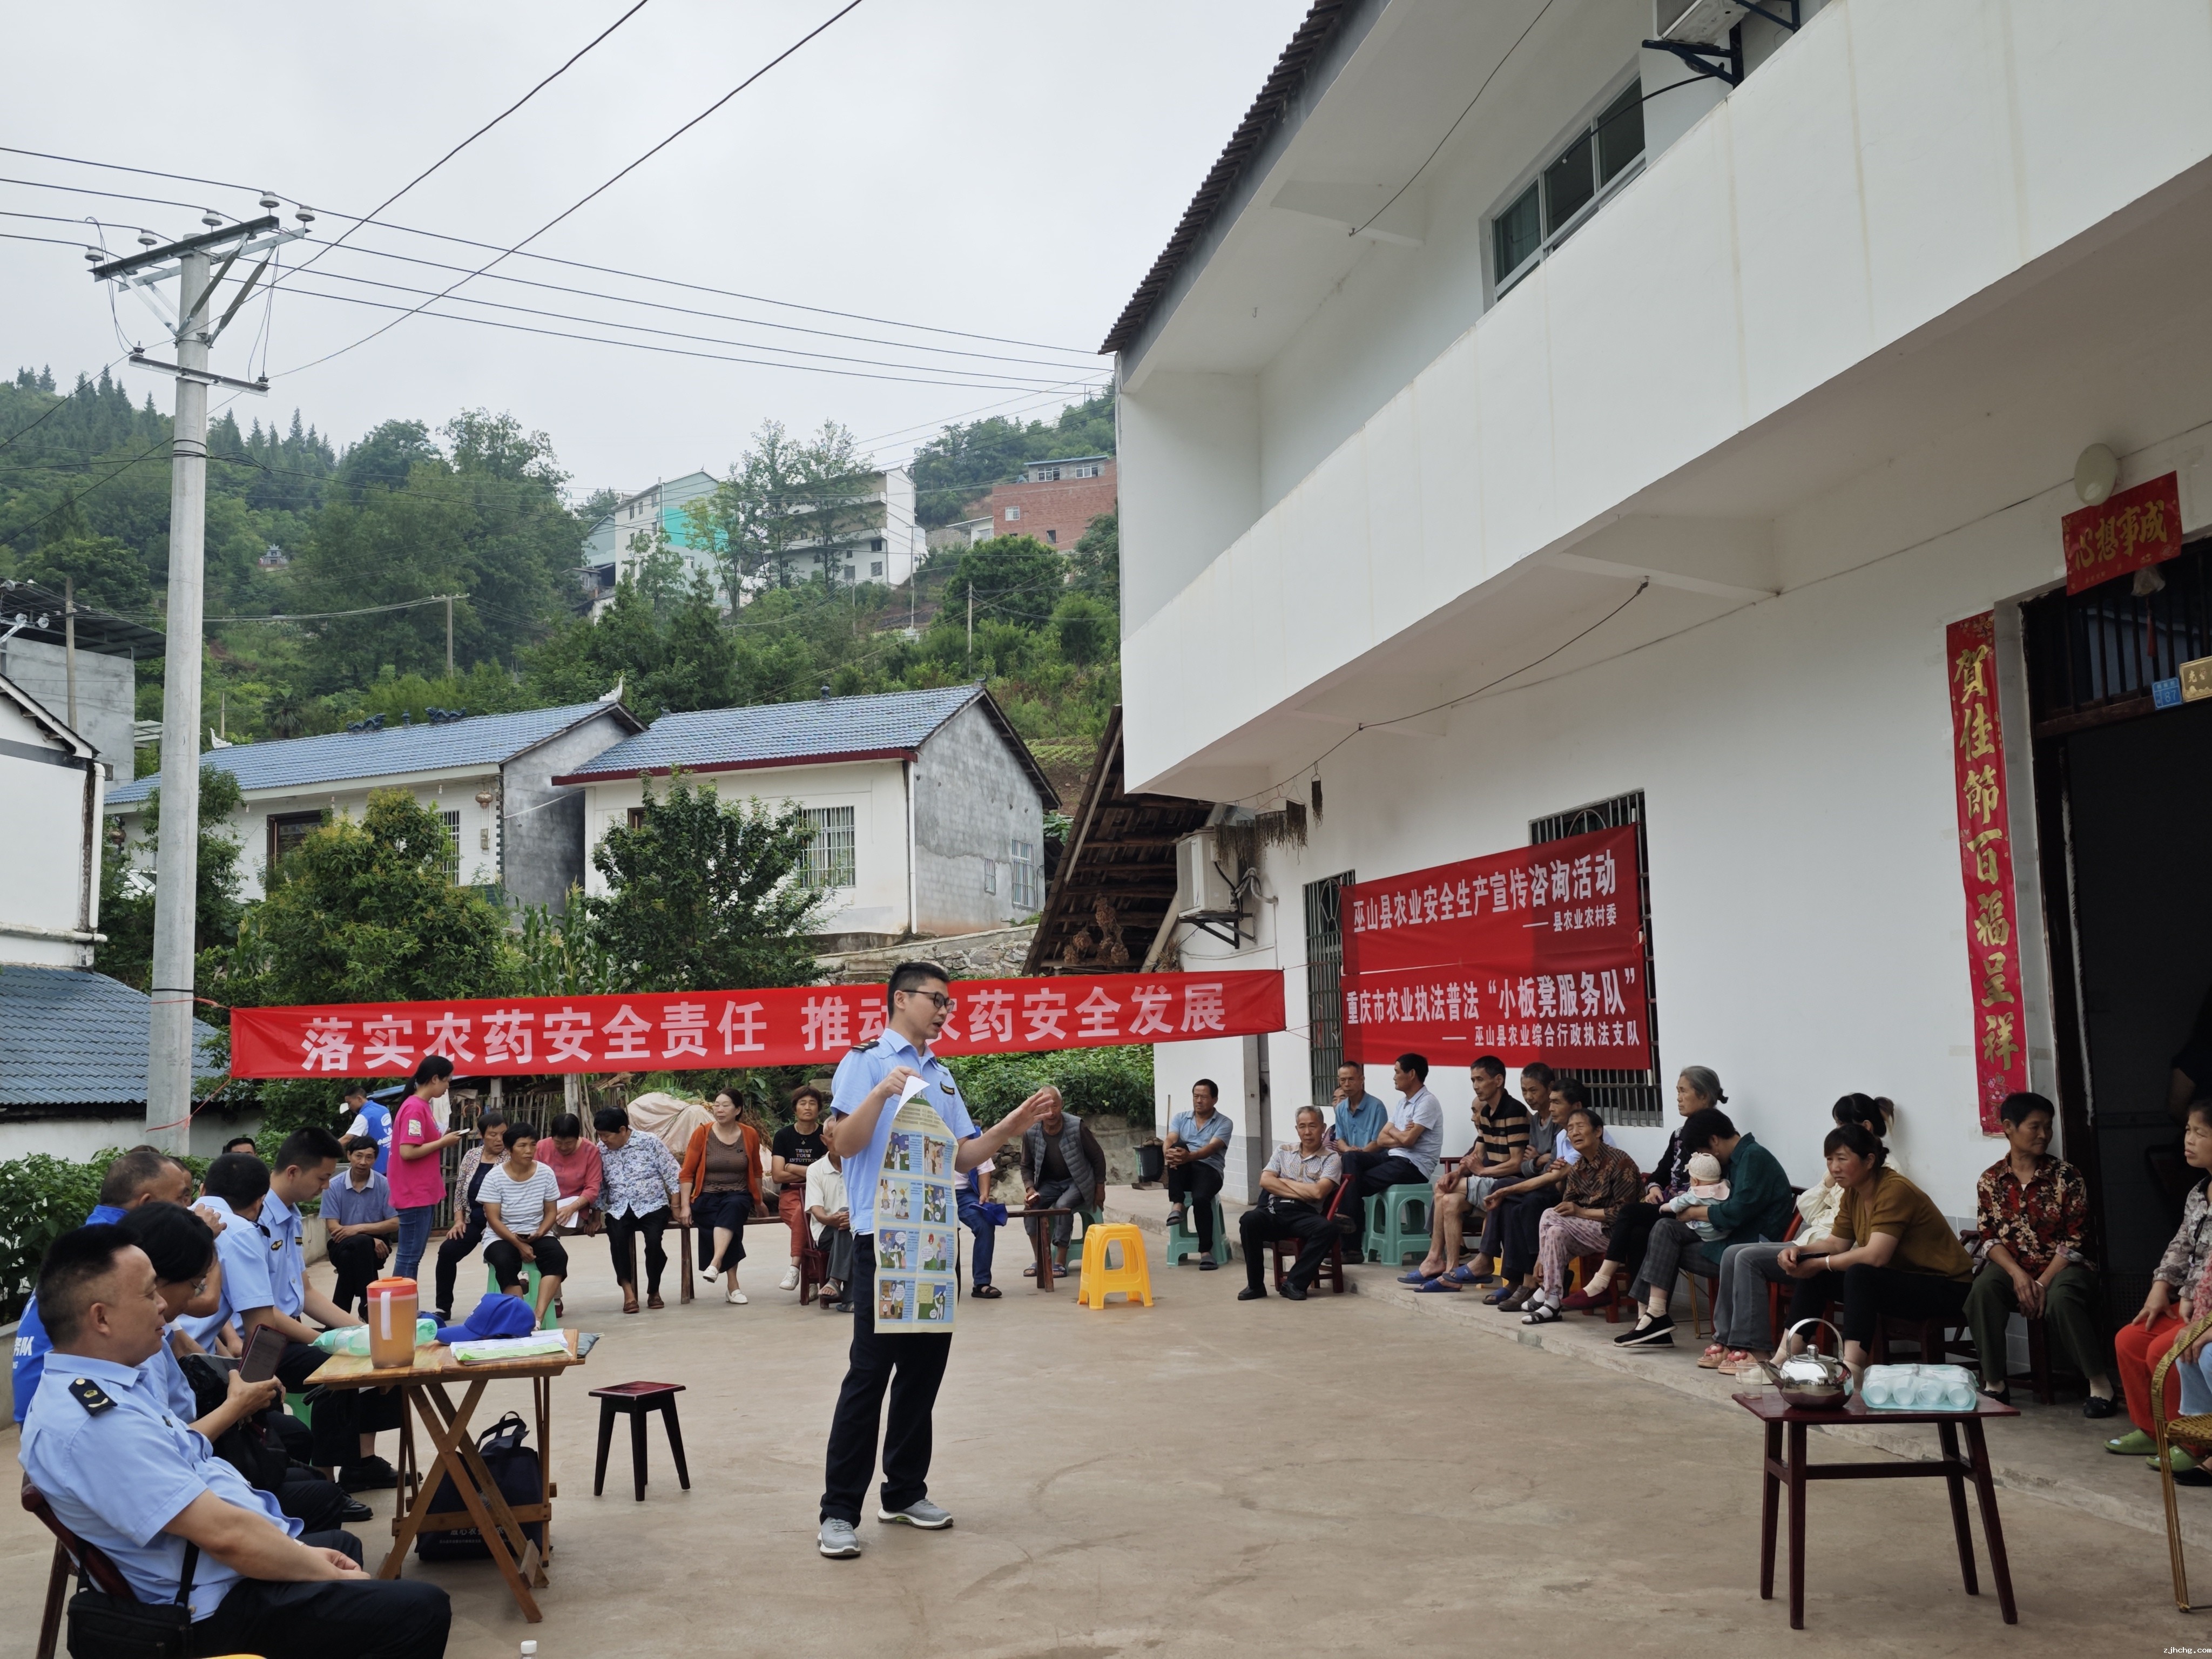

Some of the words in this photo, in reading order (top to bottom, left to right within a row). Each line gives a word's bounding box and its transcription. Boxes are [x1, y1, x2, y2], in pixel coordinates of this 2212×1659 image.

[2075, 499, 2168, 571] 心想事成
[2165, 690, 2176, 703] 87
[1353, 849, 1616, 933] 巫山县农业安全生产宣传咨询活动
[1553, 903, 1617, 932] 县农业农村委
[300, 1000, 767, 1071] 落实农药安全责任
[1475, 1020, 1640, 1047] 巫山县农业综合行政执法支队
